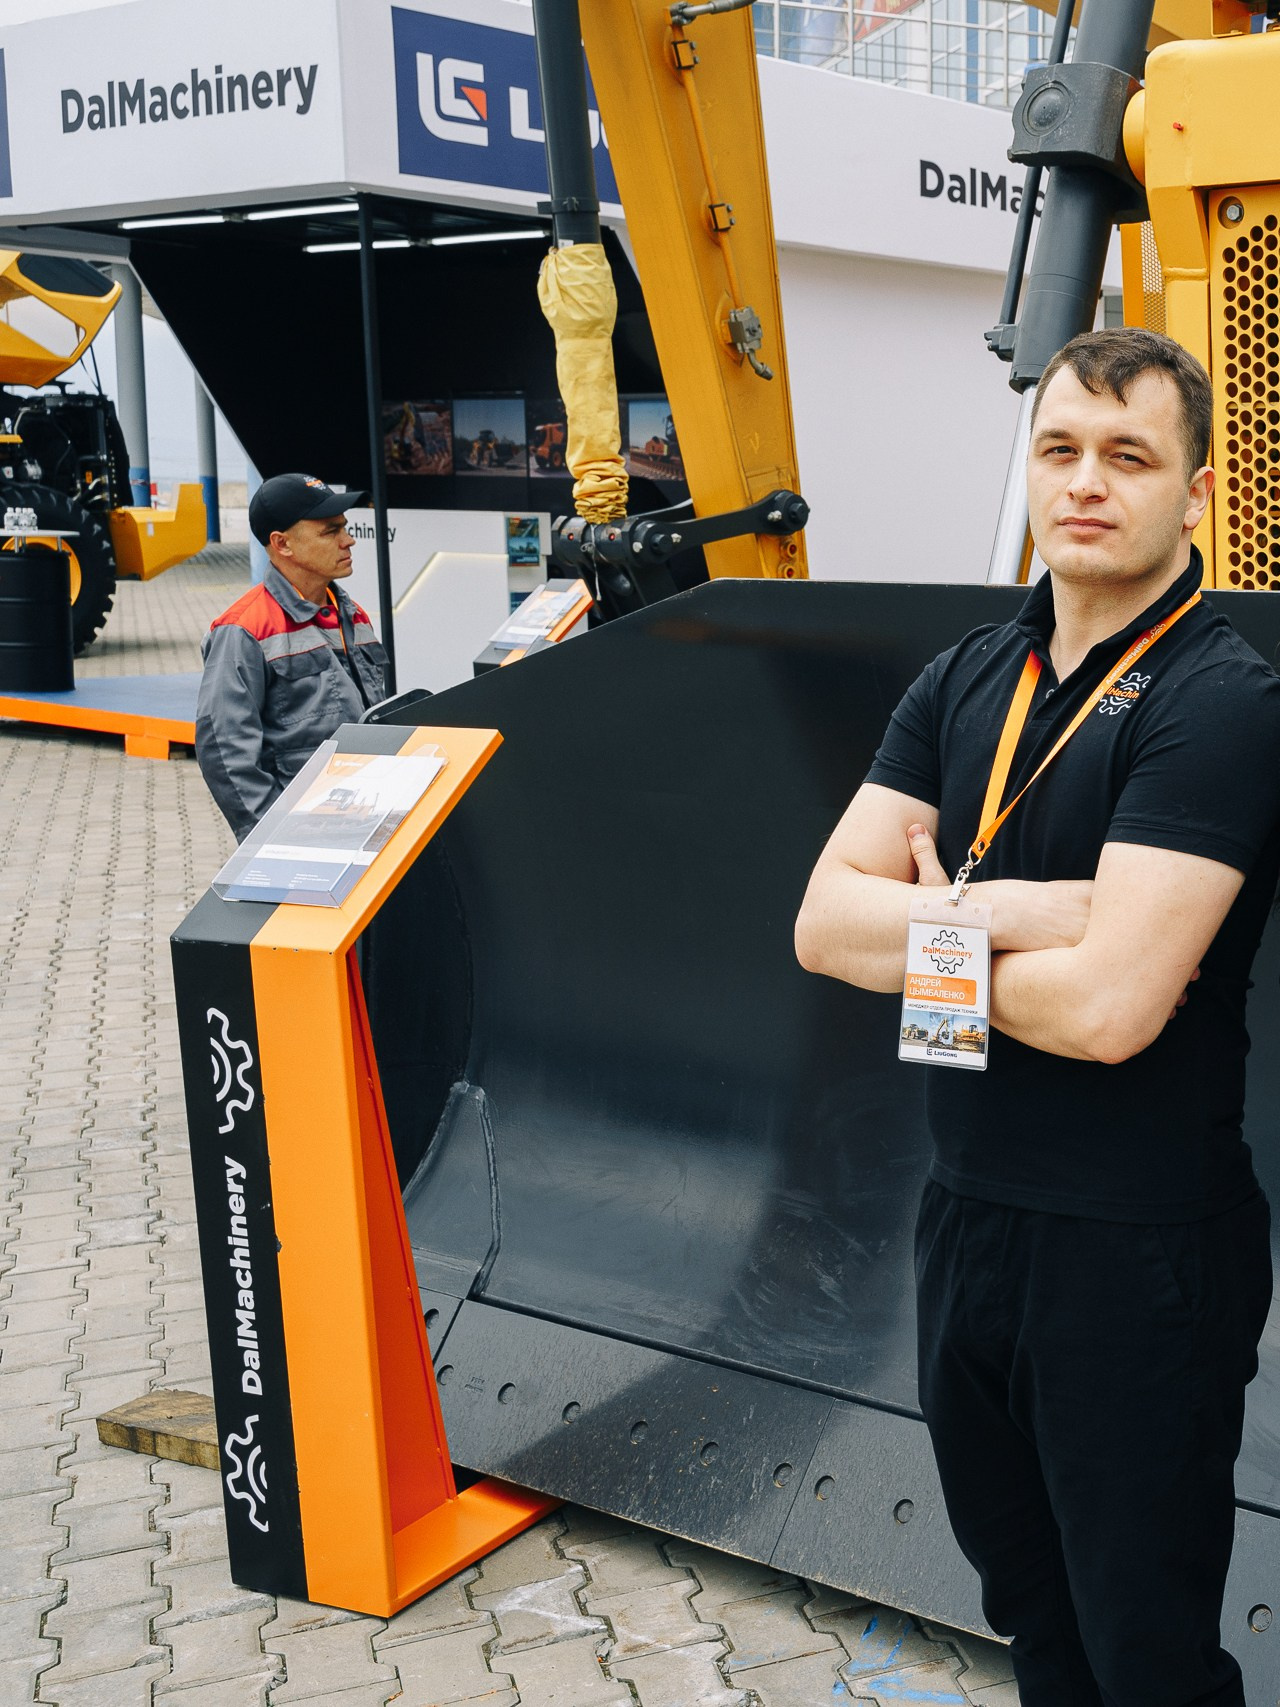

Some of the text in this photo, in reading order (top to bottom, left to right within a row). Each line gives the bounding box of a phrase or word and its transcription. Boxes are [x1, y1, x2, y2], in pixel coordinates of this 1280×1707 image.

[60, 64, 319, 134] DalMachinery
[922, 946, 973, 959] DalMachinery
[909, 976, 942, 988] АНДРЕЙ
[909, 986, 966, 1001] ЦЫМБАЛЕНКО
[224, 1155, 264, 1396] DalMachinery
